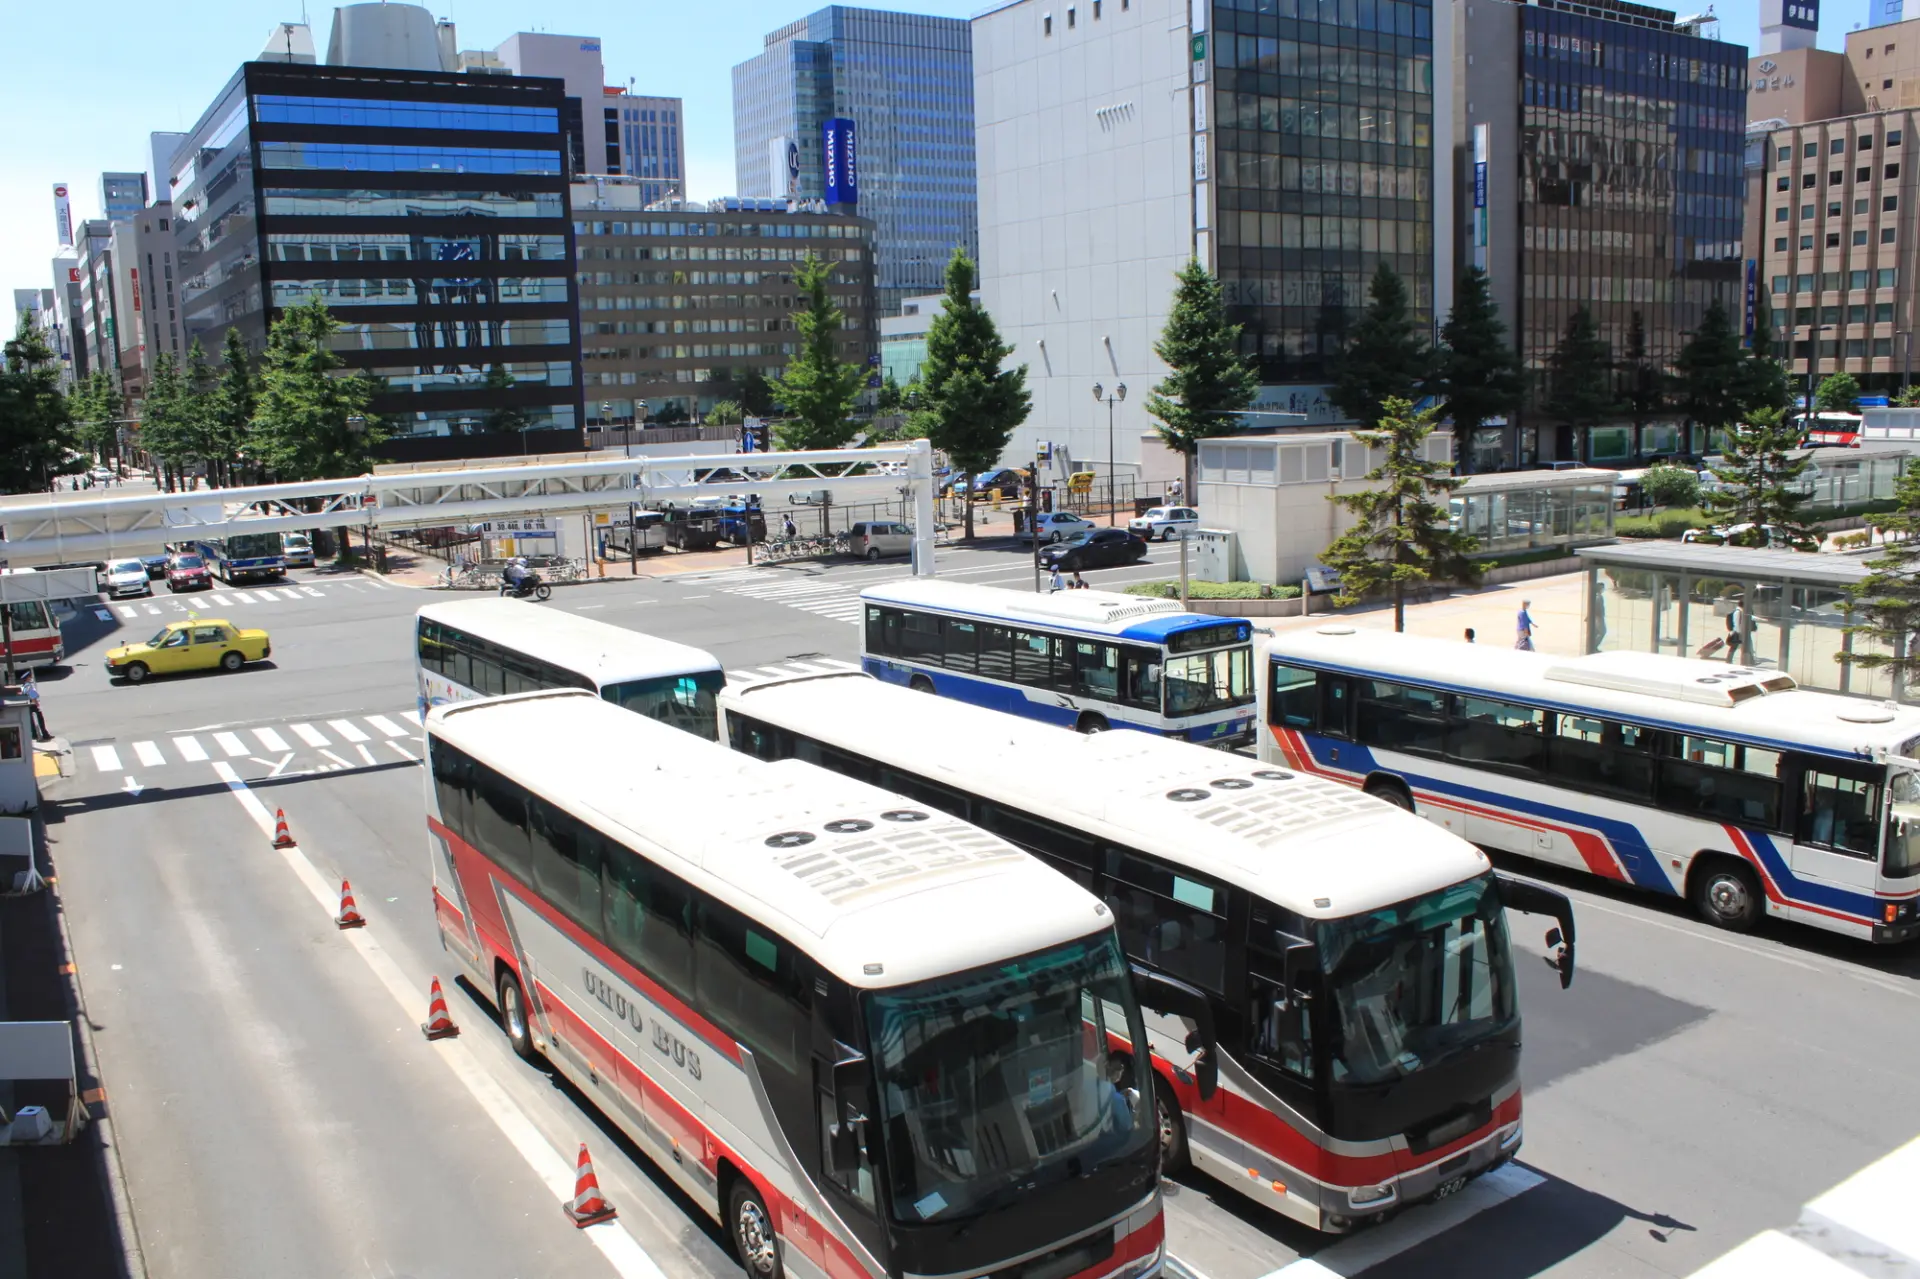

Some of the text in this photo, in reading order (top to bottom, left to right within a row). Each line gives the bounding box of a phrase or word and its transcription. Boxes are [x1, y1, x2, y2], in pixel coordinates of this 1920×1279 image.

[827, 130, 835, 188] MIZUHO
[846, 130, 854, 187] MIZUHO
[582, 966, 702, 1081] CHUO BUS
